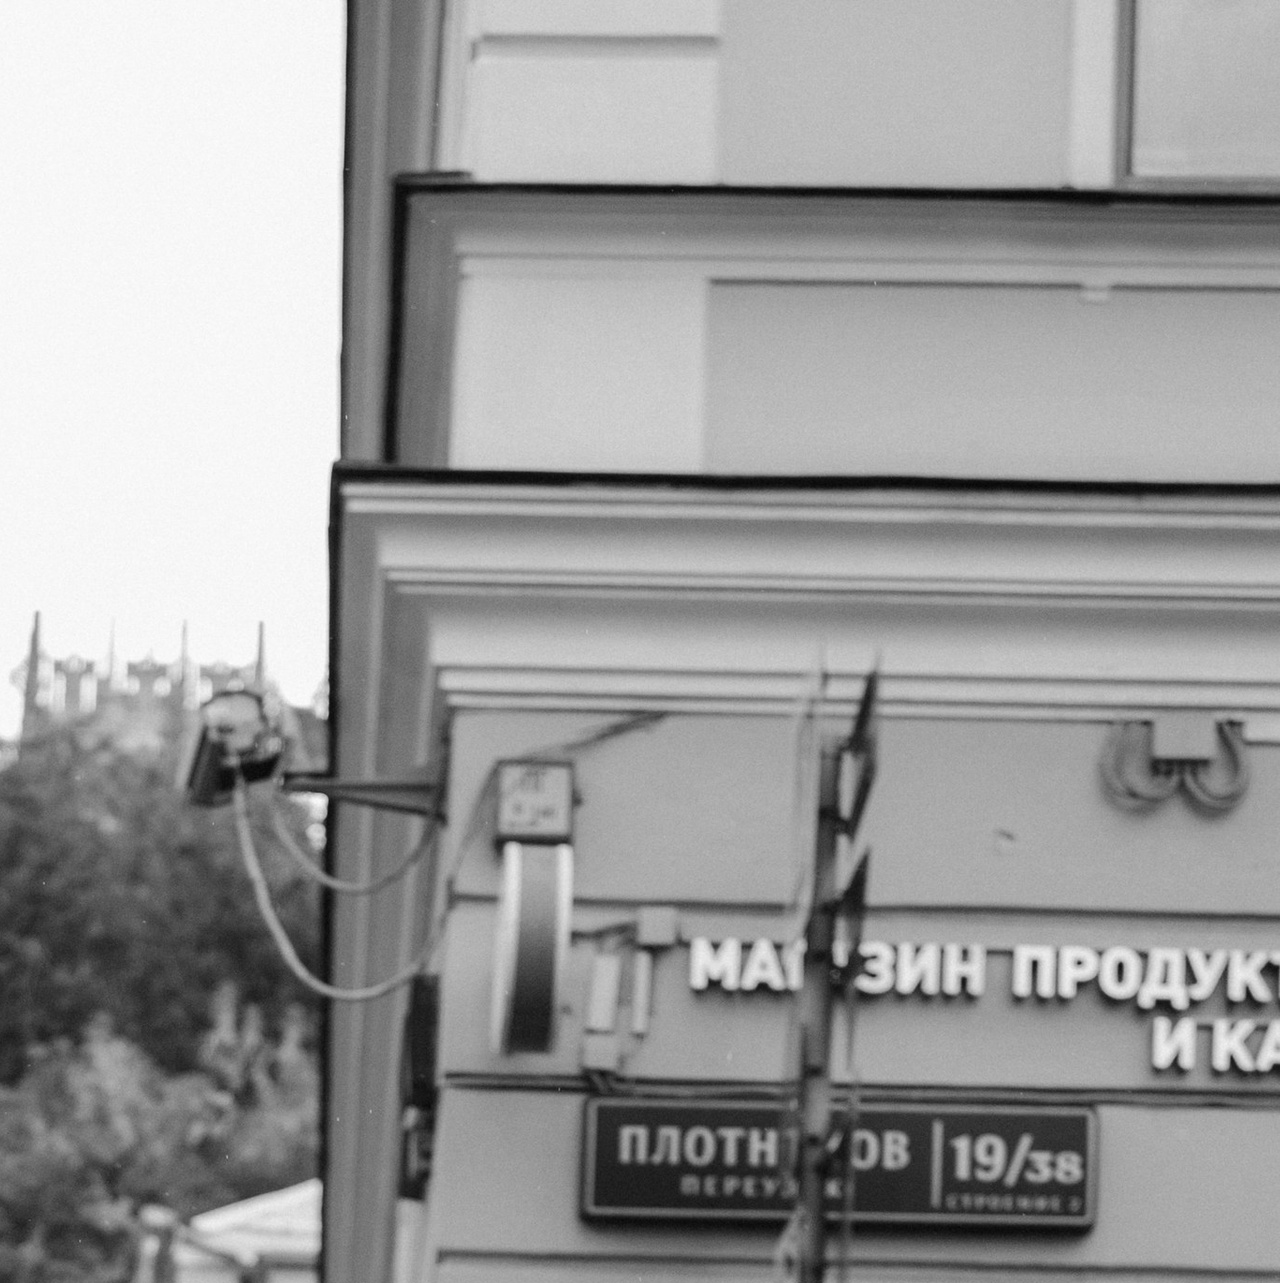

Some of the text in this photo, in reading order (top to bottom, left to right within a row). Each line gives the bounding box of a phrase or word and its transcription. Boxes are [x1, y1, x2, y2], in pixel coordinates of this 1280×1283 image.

[690, 936, 1280, 1010] МАГЗИН ПРОДУК
[1152, 1015, 1197, 1070] И
[618, 1124, 912, 1171] ПЛОТНОВ
[949, 1132, 1084, 1188] 19/38
